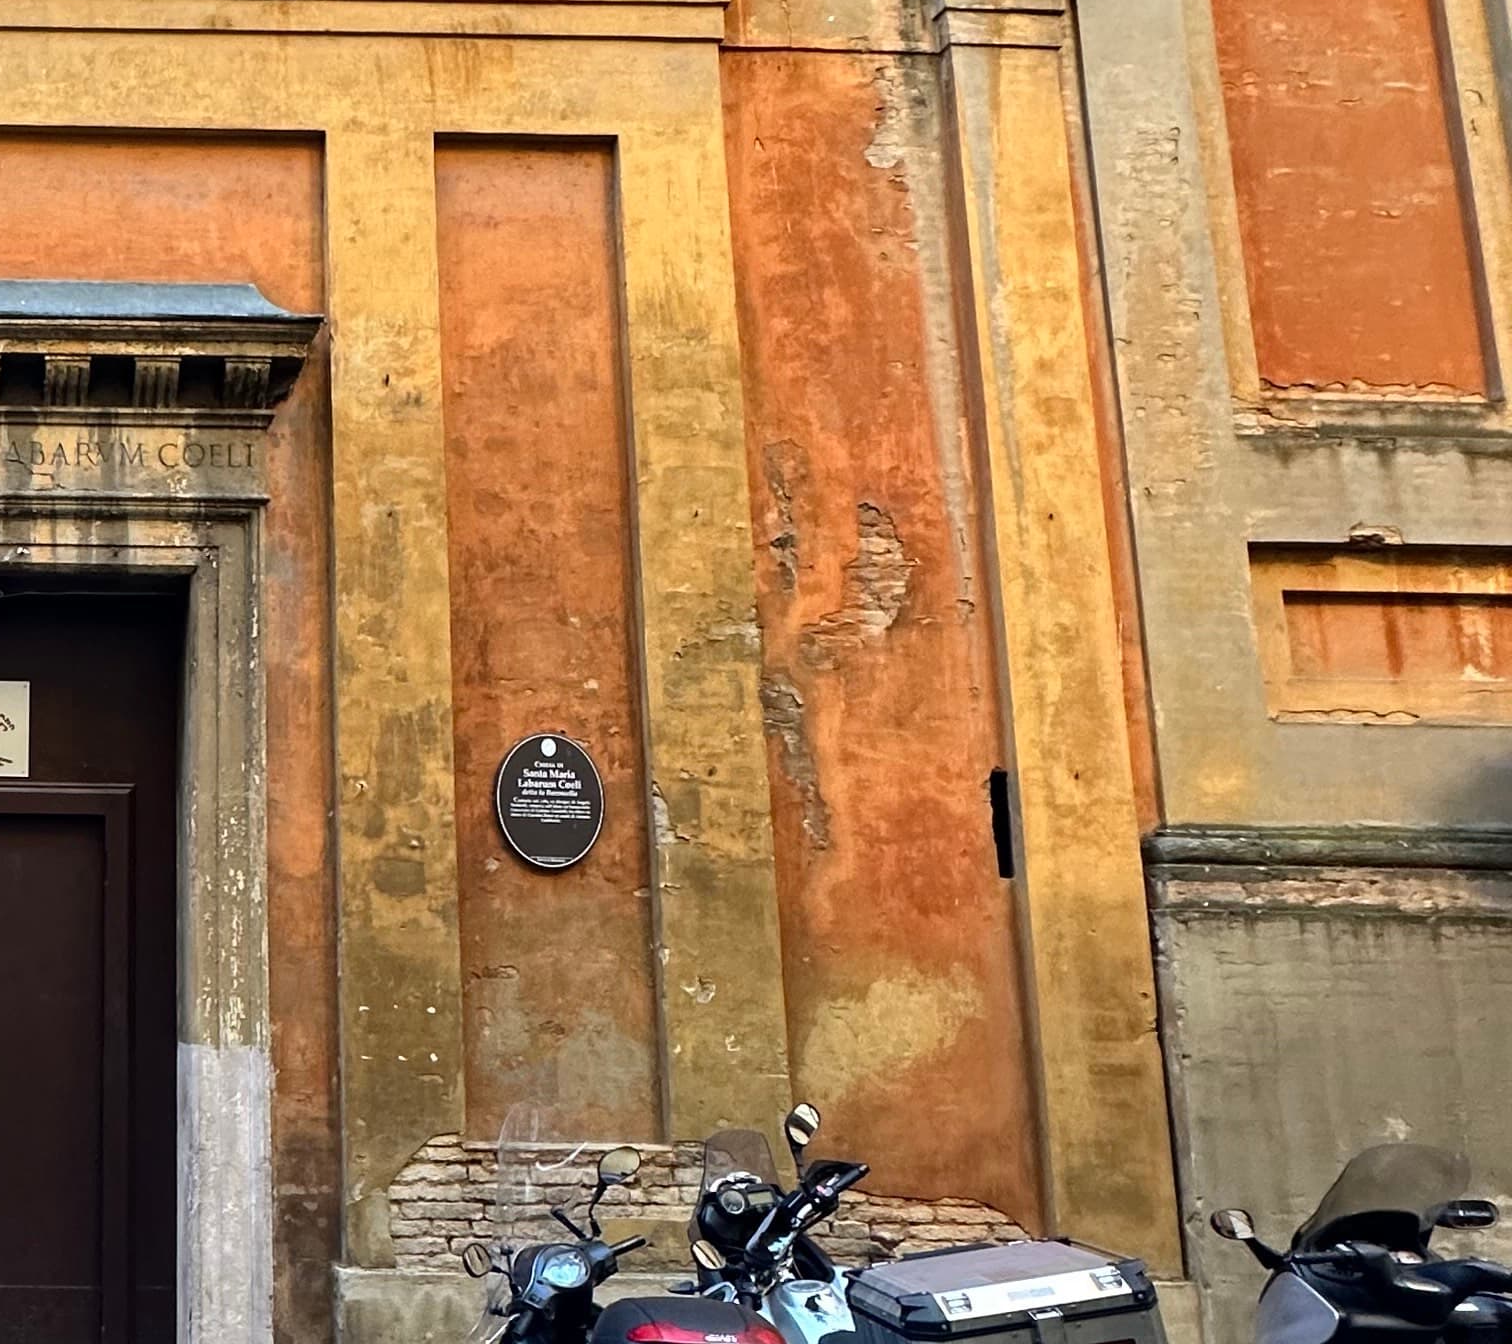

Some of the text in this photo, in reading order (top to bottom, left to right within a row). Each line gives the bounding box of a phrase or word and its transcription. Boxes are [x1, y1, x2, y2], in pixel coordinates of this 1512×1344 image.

[158, 442, 257, 468] COELI
[522, 768, 576, 779] Santa Maria
